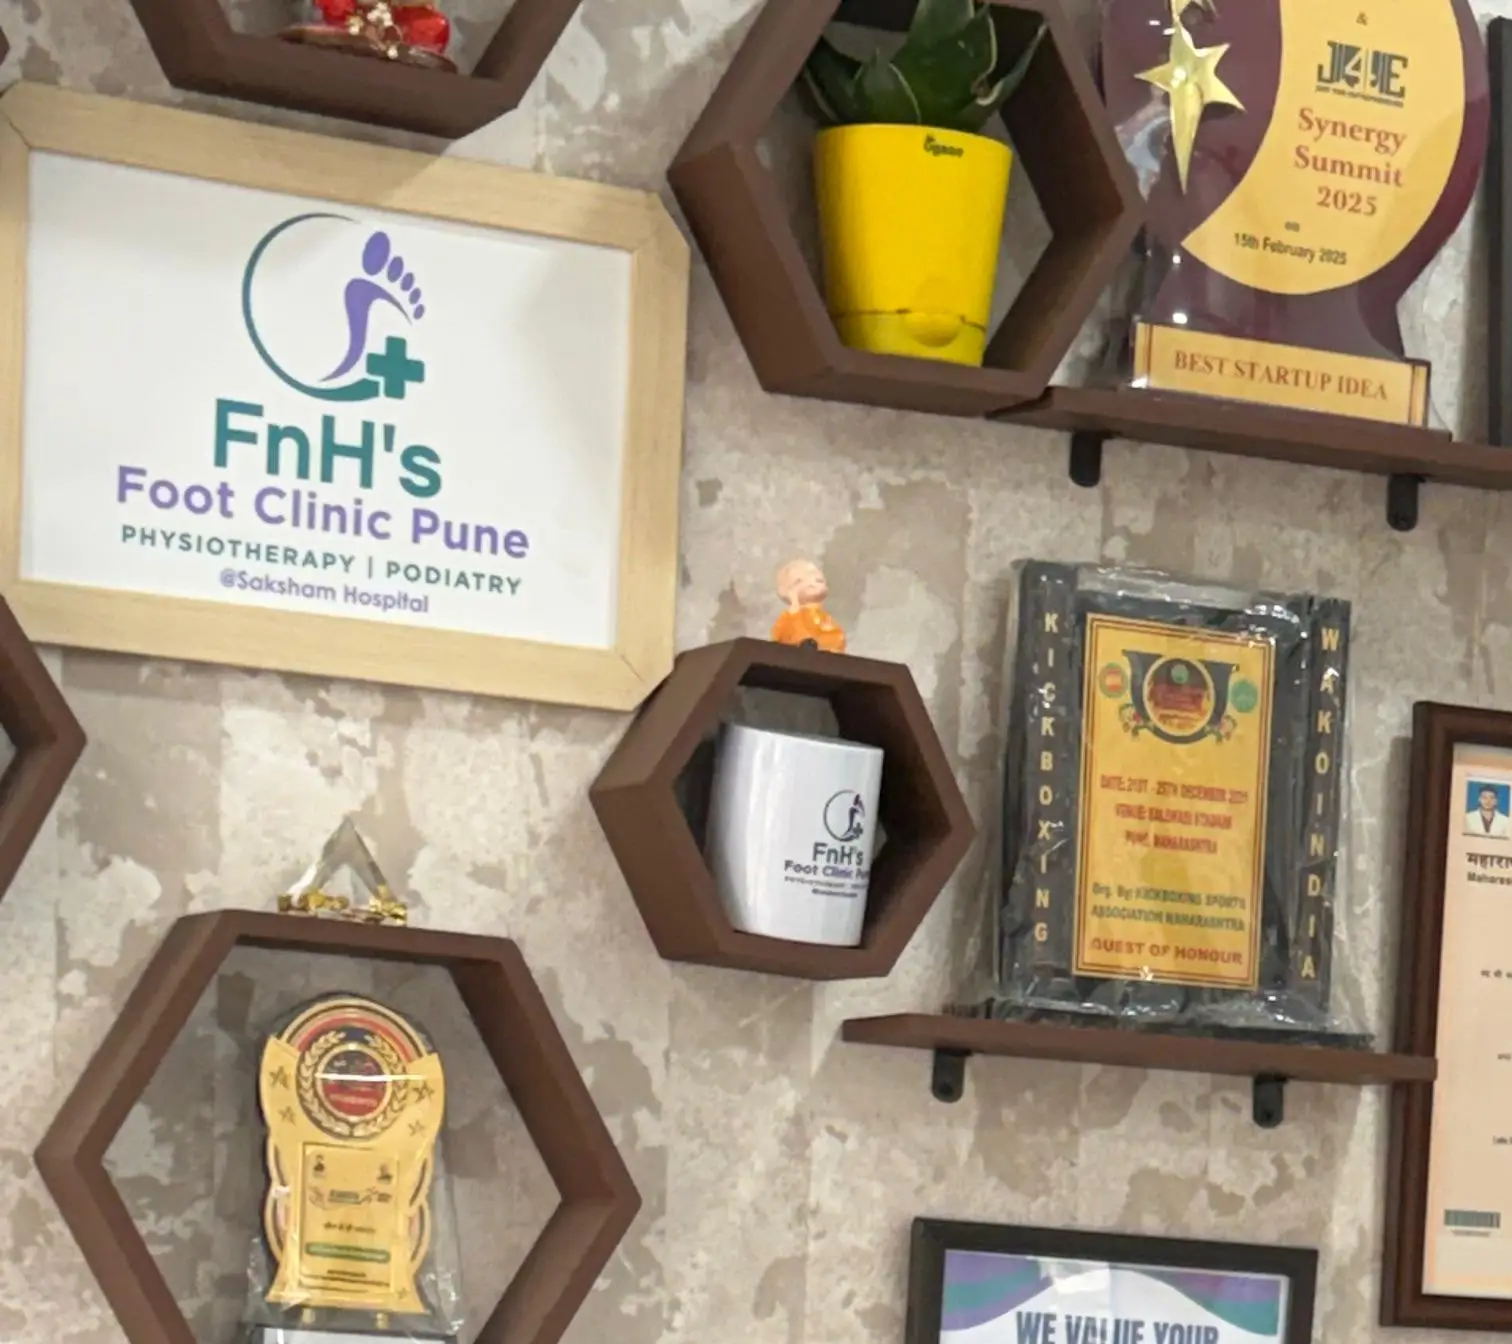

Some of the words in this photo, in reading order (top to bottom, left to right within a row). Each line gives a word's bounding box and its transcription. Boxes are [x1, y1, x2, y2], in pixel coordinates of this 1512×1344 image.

[1298, 107, 1408, 156] Synergy
[1293, 144, 1404, 188] Summit
[1316, 185, 1378, 218] 2025
[1233, 232, 1260, 252] 15th
[1262, 235, 1316, 263] February
[1318, 247, 1348, 267] 2025
[1173, 348, 1229, 377] BEST
[1233, 358, 1332, 393] STARTUP
[1336, 373, 1388, 401] IDEA
[213, 397, 443, 498] FnH's
[115, 465, 236, 518] Foot
[253, 486, 392, 542] Clinic
[410, 508, 530, 560] Pune
[121, 524, 356, 573] PHYSIOTHERAPY
[385, 560, 523, 596] PODIATRY
[219, 569, 337, 602] @Saksham
[342, 587, 430, 613] Hospital
[784, 860, 818, 876] Foot
[812, 842, 863, 866] FnH's
[1149, 944, 1170, 957] OF
[1175, 944, 1243, 966] HONOUR
